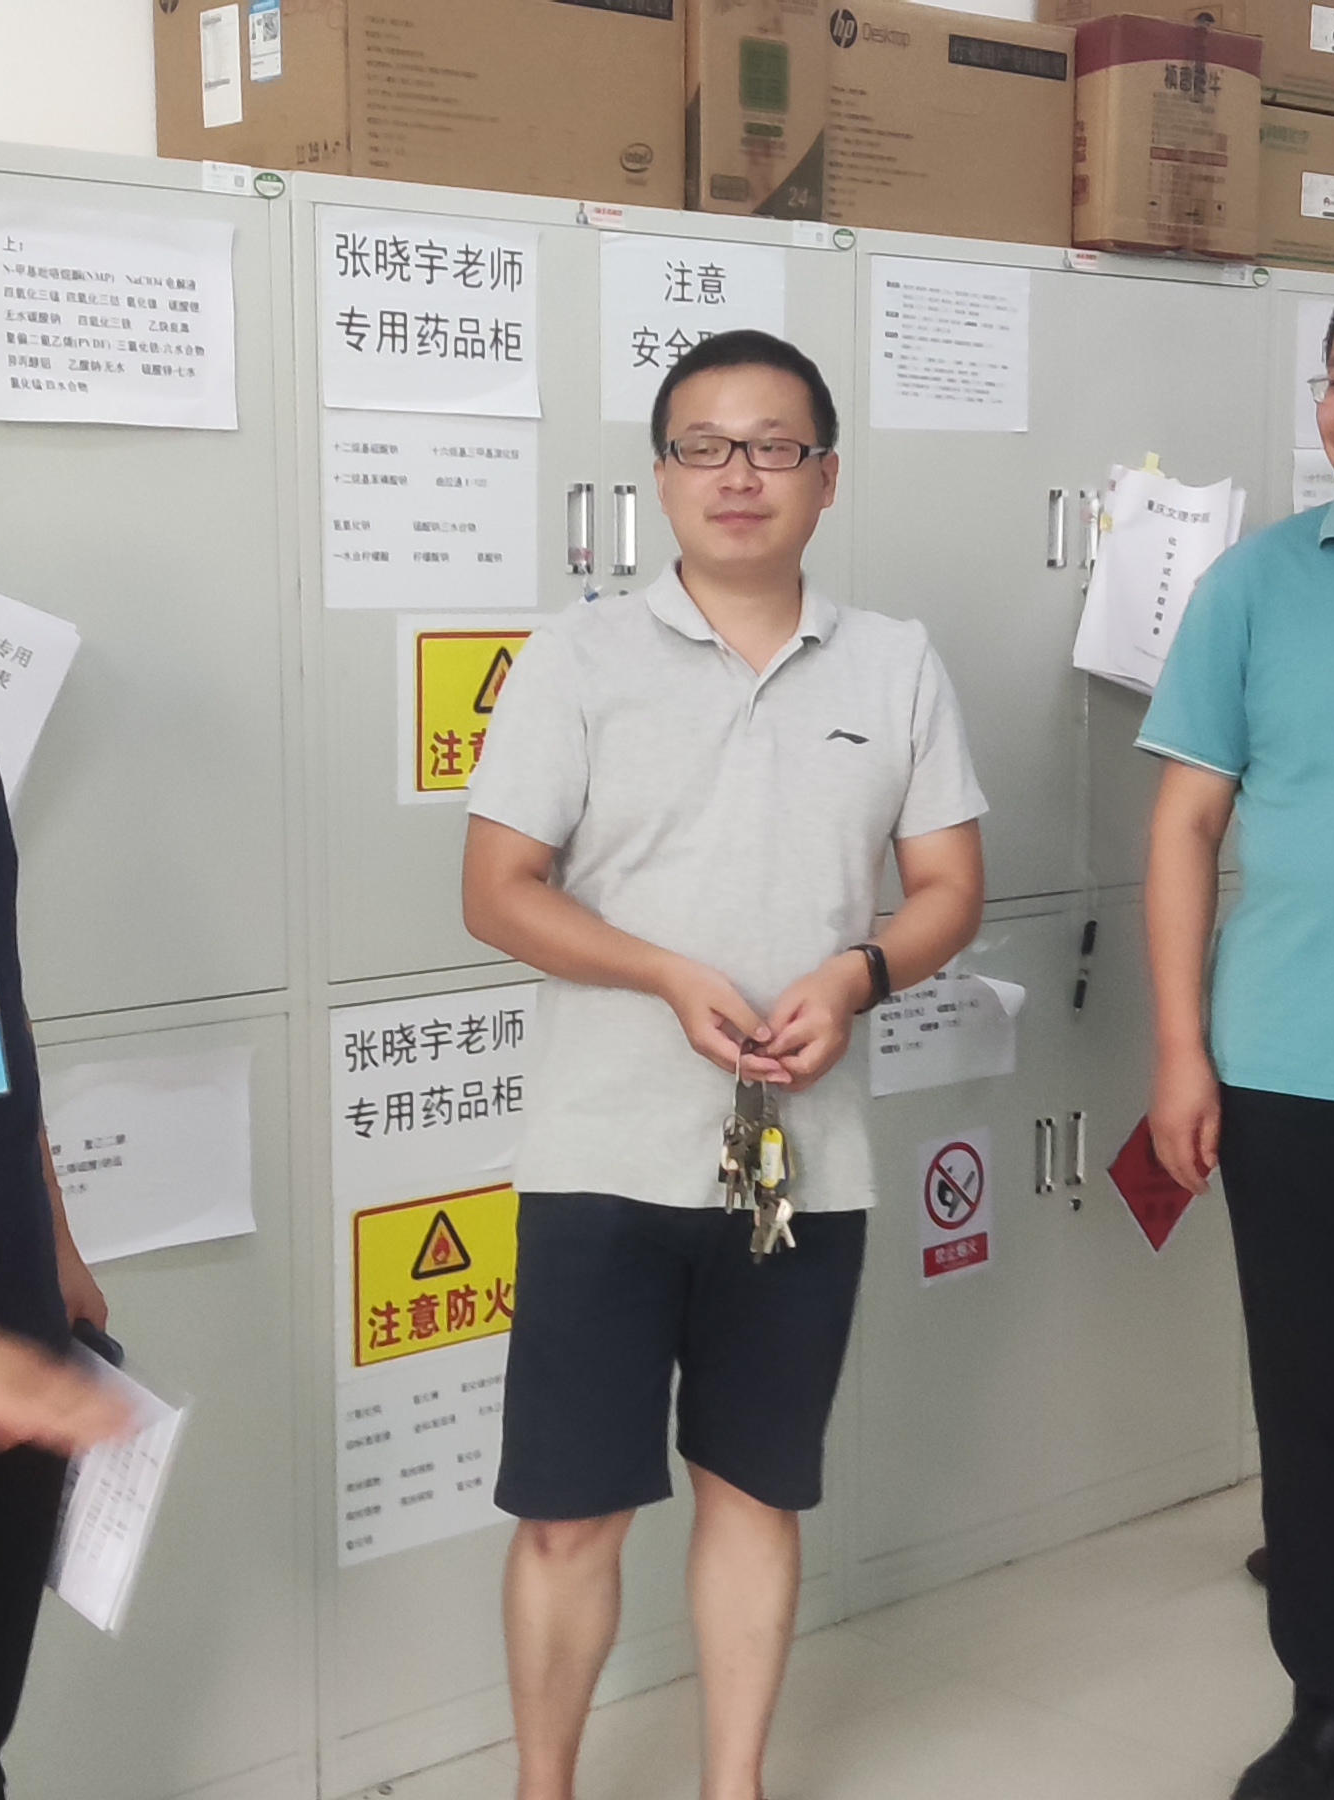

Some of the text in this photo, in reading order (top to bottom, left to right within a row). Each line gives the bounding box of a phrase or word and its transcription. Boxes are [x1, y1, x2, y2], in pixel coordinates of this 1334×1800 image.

[335, 231, 524, 293] 张晓宇老师
[663, 260, 727, 305] 注意
[335, 304, 524, 363] 专用药品柜
[631, 324, 713, 369] 安全
[344, 1009, 524, 1072] 张晓宇老师
[344, 1074, 524, 1138] 专用药品柜
[367, 1277, 515, 1350] 注意防火
